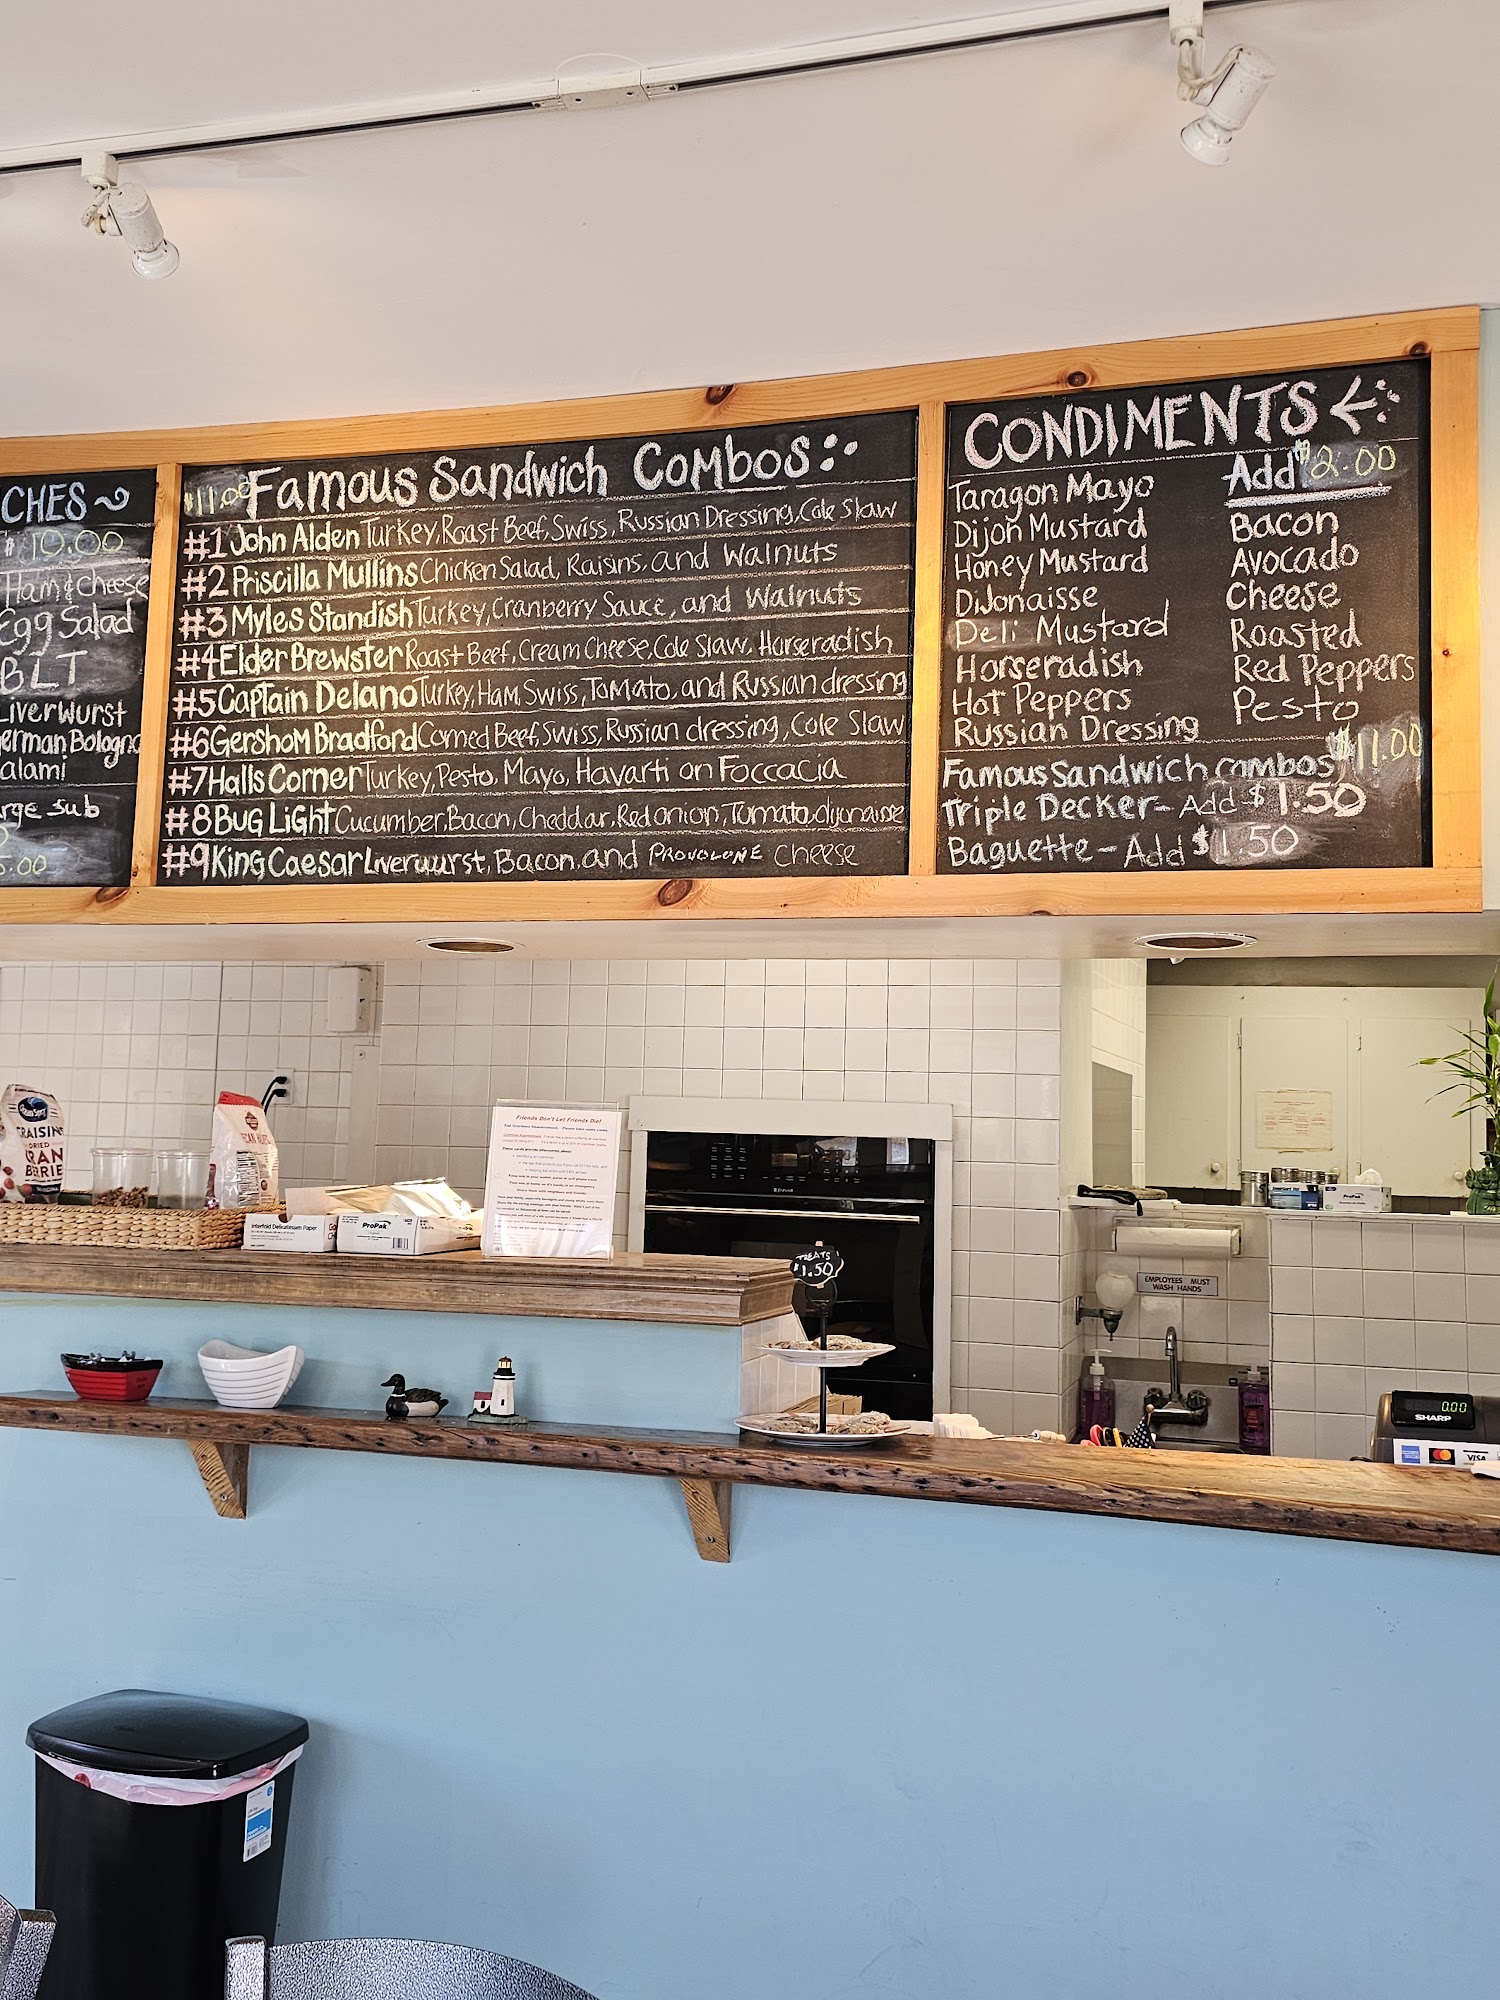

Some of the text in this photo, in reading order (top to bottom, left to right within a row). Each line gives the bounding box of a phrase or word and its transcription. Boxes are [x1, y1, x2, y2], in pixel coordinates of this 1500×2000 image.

[965, 379, 1319, 469] CONDIMENTS
[246, 466, 418, 520] Famous
[429, 445, 608, 502] Sandwich
[1221, 438, 1397, 496] Add $2.00
[2, 482, 88, 523] CHES
[949, 471, 1155, 523] Taragon Mayo
[183, 496, 898, 562] #1 John Alden Turkey, Roast Beef, Swiss, Russian Dressing, Cole Slaw
[953, 507, 1148, 559] Dijon Mustard
[1230, 510, 1339, 543] Bacon
[180, 541, 838, 601] #2 Priscilla Mullins Chicken Salad, Raisins, and Walnuts
[954, 544, 1149, 590] Honey Mustard
[1230, 536, 1360, 578] Avocado
[2, 570, 60, 608] Ham
[178, 580, 863, 641] #3 Myles Standish Turkey, Cranberry Sauce, and Walnuts
[0, 597, 135, 657] Egg Salad
[954, 598, 1170, 651] Deli Mustard
[1230, 608, 1363, 653] Roasted
[0, 650, 89, 694] BLT
[175, 625, 895, 681] #4 Elder Brewster Roast Beef, Cream Cheese, Cole Slaw, Horseradish
[955, 647, 1144, 683] Horseradish
[1232, 652, 1416, 693] Red Peppers
[172, 687, 218, 720] #5
[315, 679, 418, 714] Delano
[411, 675, 476, 711] Turkey,
[522, 677, 587, 709] Swiss,
[681, 671, 726, 702] and
[732, 669, 817, 700] Russian
[820, 666, 908, 698] dressing
[951, 681, 1133, 721] Hot Peppers
[1232, 684, 1360, 725] Pesto
[0, 728, 68, 756] erman
[168, 726, 211, 759] #6
[314, 718, 418, 756] Bradford
[418, 719, 490, 750] Corned
[493, 721, 541, 749] Beef,
[542, 720, 602, 747] Swiss,
[606, 717, 680, 743] Russian
[790, 711, 839, 736] Cole
[849, 709, 906, 737] Slaw
[953, 712, 1200, 748] Russian Dressing
[167, 752, 848, 797] #7 Halls Corner Turkey, Pesto, Mayo, Havarti on Foccacia
[942, 757, 1049, 790] Famous
[1049, 753, 1209, 788] Sandwich
[164, 803, 212, 837] #8
[334, 803, 448, 835] Cucumber,
[446, 803, 518, 832] Bacon,
[518, 804, 616, 831] Cheddar,
[616, 803, 652, 828] Red
[941, 781, 1368, 836] Triple Add $1.50
[161, 842, 211, 882] #9
[267, 846, 365, 879] Caesar
[494, 847, 582, 875] Bacon,
[581, 838, 640, 871] and
[947, 824, 1299, 871] Baguette Add $1.50
[361, 1221, 388, 1230] ProPak
[795, 1250, 831, 1261] TREATS
[1144, 1275, 1211, 1286] EMPLOYEES MUST
[1152, 1283, 1202, 1292] WASH HANDS
[1414, 1413, 1452, 1422] SHARP
[1441, 1400, 1468, 1413] 0.00
